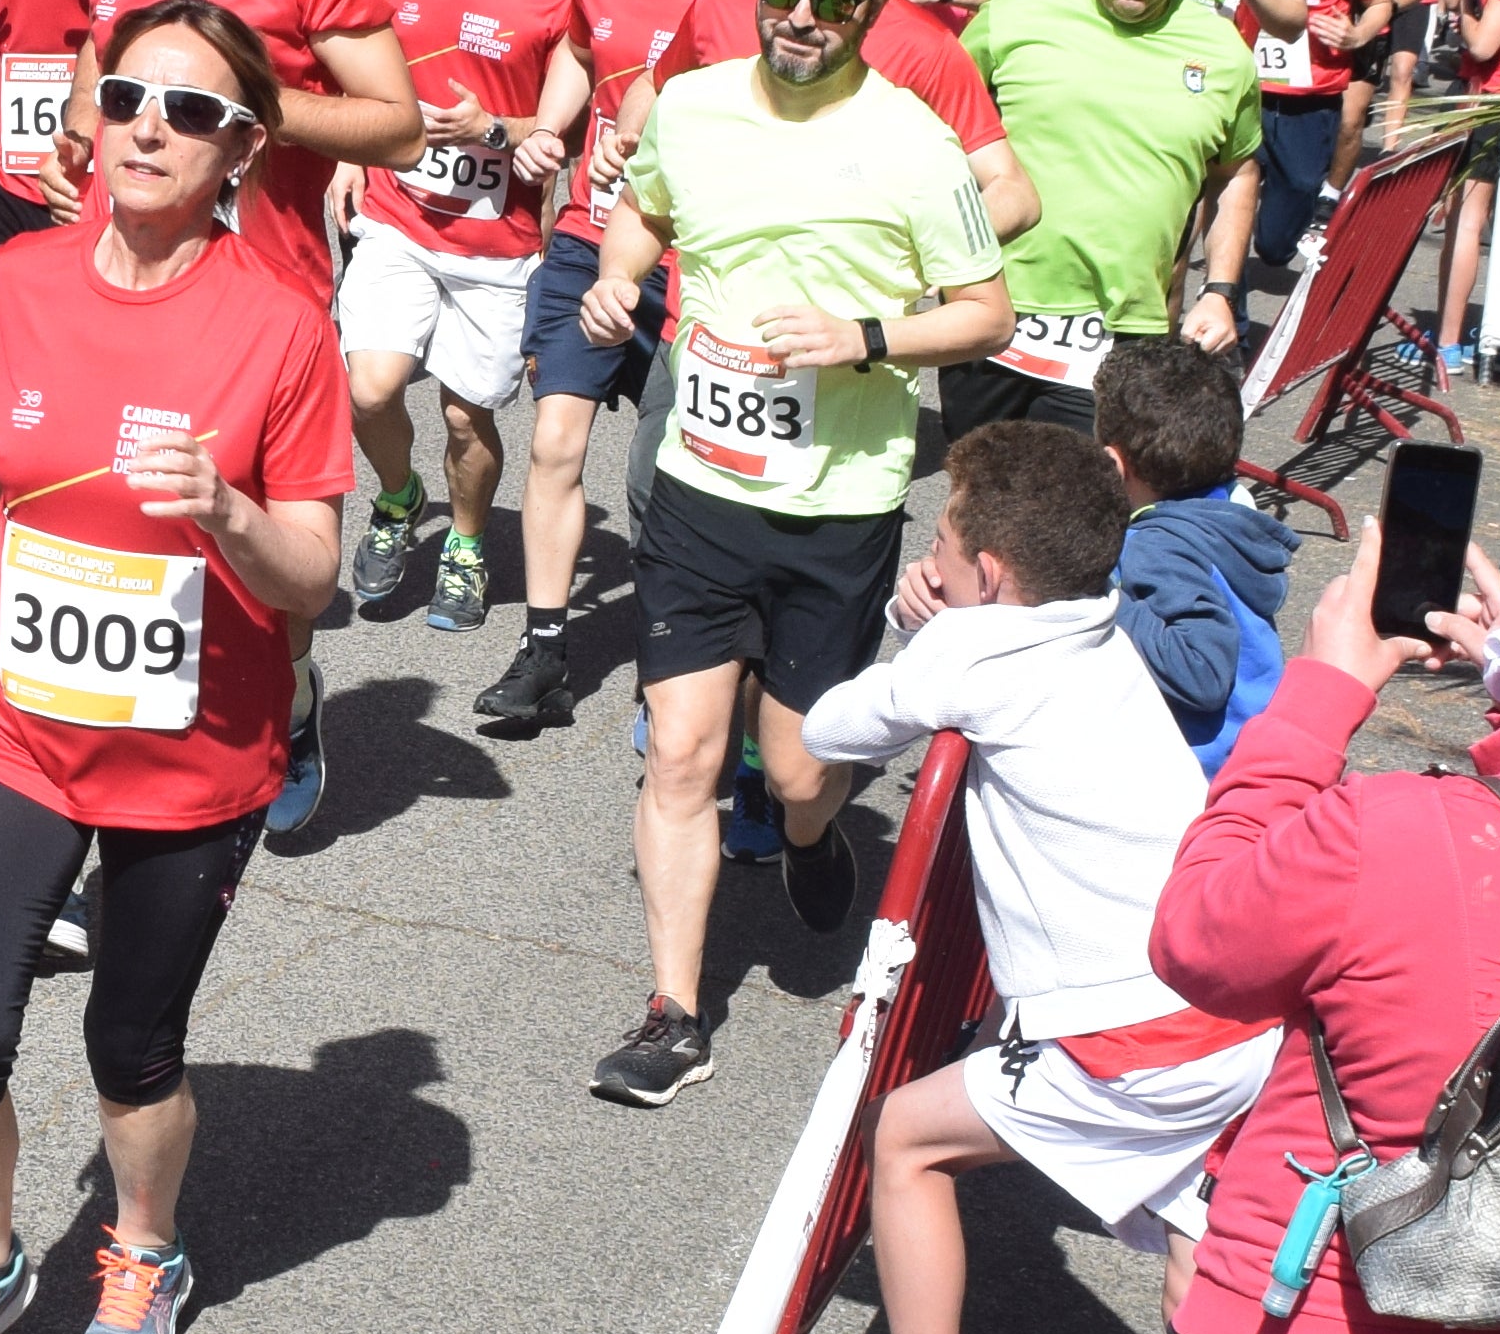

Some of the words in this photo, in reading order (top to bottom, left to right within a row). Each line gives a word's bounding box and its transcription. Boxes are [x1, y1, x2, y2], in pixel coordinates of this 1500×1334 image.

[459, 31, 511, 53] UNIVERSIDAD
[461, 22, 494, 38] CAMPUS
[415, 146, 502, 190] 505
[1016, 314, 1106, 352] 519
[122, 405, 192, 430] CARRERA
[686, 373, 802, 441] 1583
[15, 551, 84, 582] UNIVERSIDAD
[84, 570, 100, 585] DE
[101, 573, 118, 588] LA
[119, 576, 153, 591] RIOJA
[19, 538, 67, 565] CARRERA
[67, 551, 115, 573] CAMPUS
[10, 592, 187, 675] 3009
